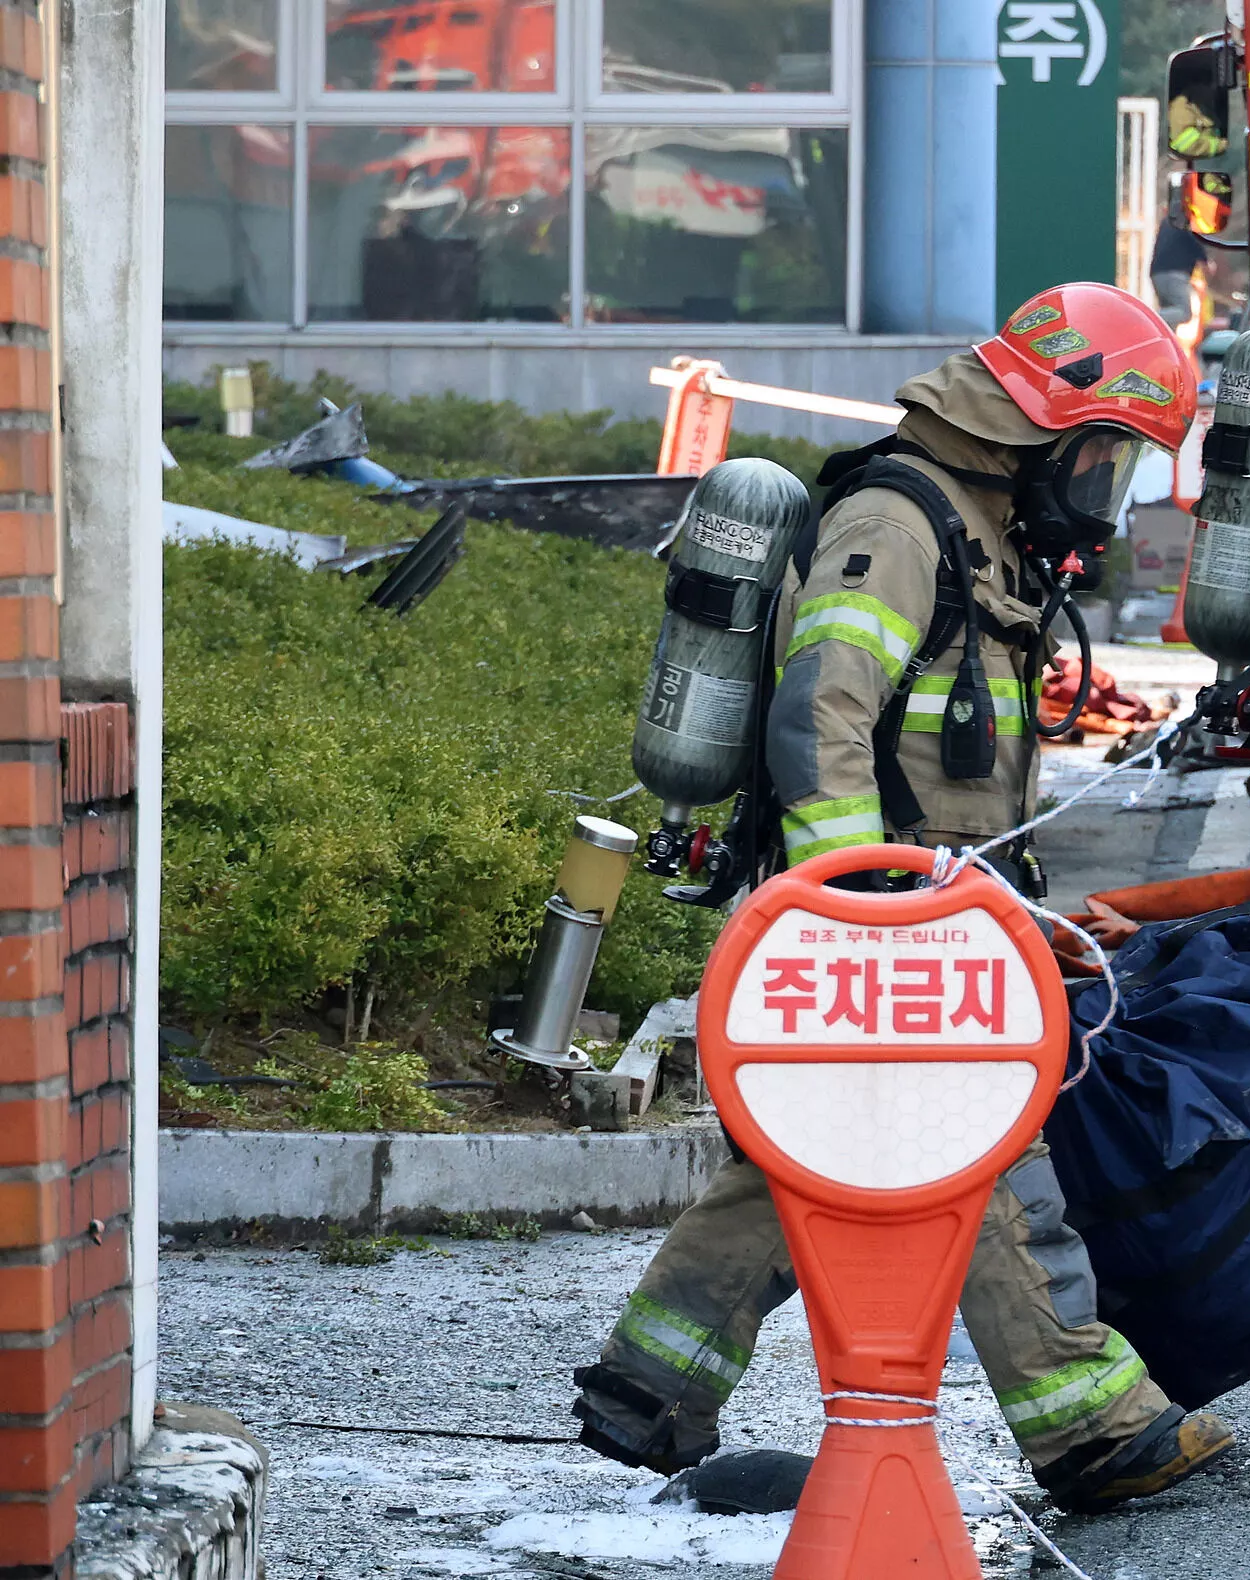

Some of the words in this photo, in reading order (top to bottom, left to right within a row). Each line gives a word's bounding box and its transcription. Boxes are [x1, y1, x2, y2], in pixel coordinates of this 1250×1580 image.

[653, 666, 683, 728] 공기
[799, 929, 837, 944] 협조
[845, 929, 884, 944] 부탁
[892, 929, 970, 944] 드립니다
[762, 957, 1006, 1035] 주차금지
